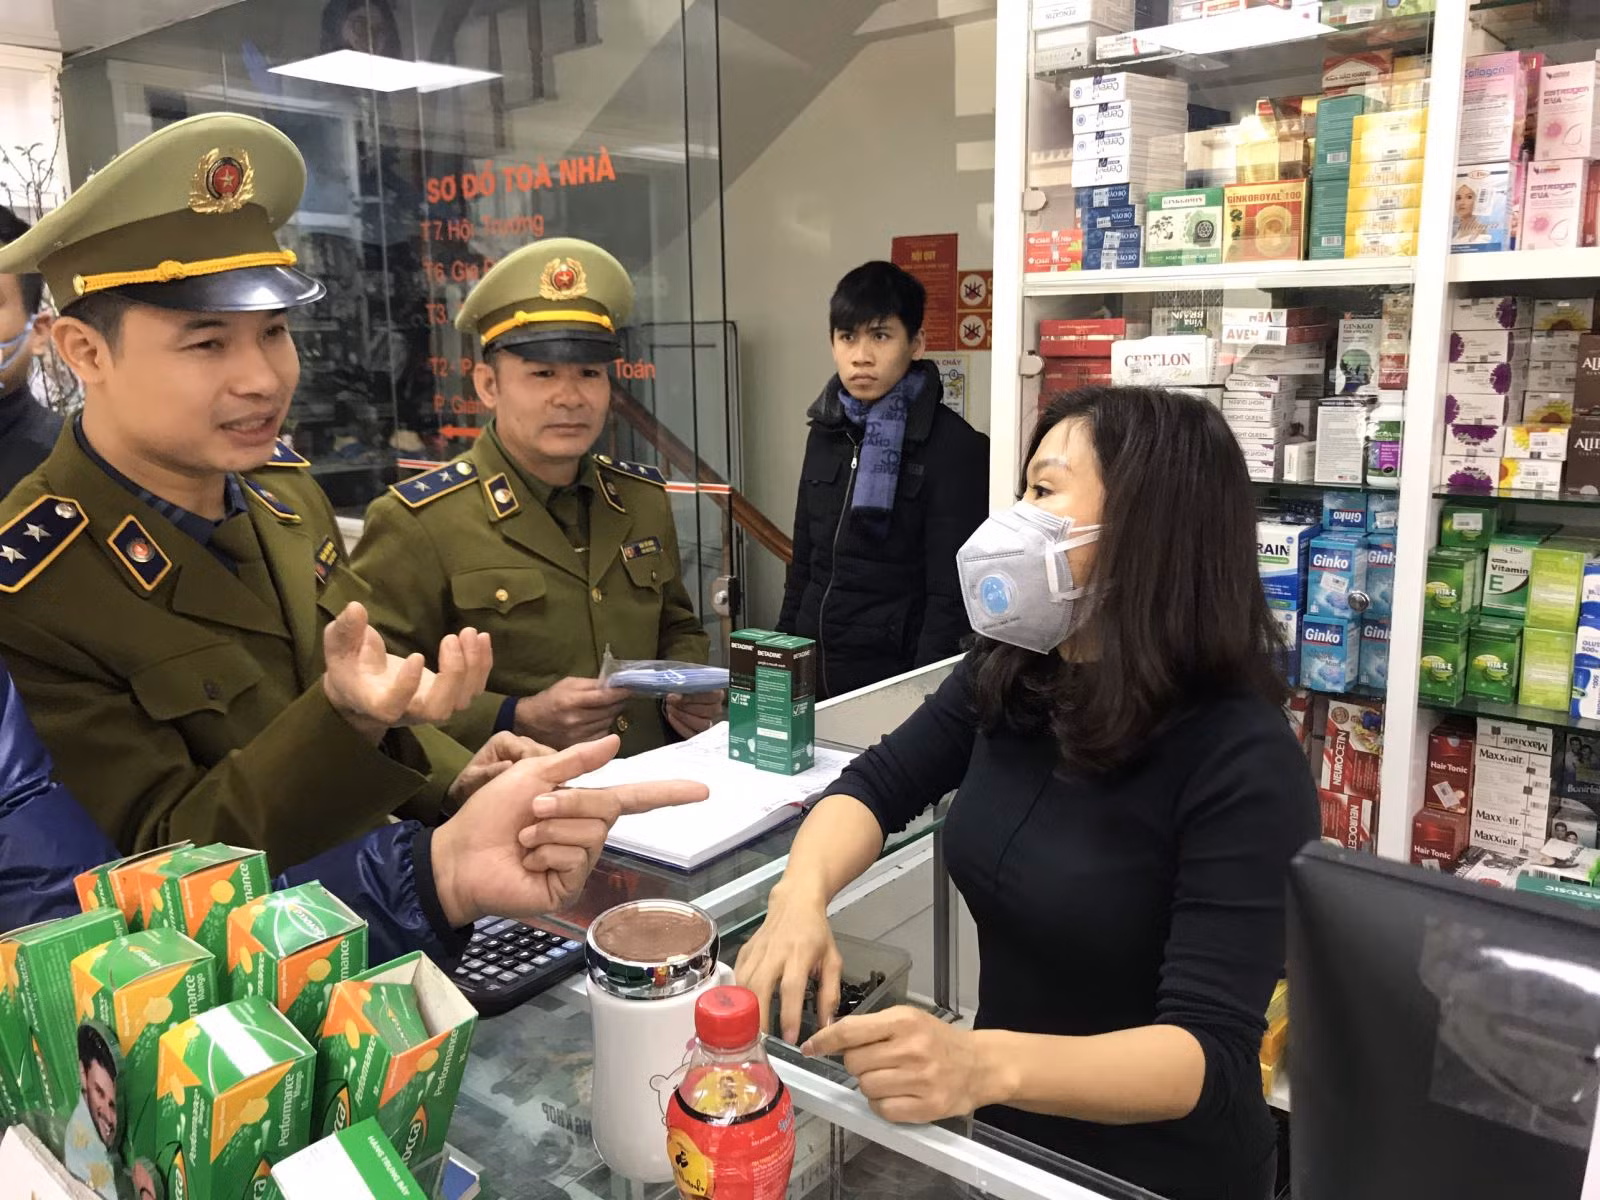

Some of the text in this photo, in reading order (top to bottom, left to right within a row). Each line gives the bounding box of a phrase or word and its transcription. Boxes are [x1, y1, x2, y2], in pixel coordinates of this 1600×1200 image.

[559, 146, 616, 187] NHÀ
[1285, 190, 1301, 201] 100
[614, 357, 656, 380] Toán
[1333, 511, 1363, 524] Ginko
[1313, 553, 1349, 570] Ginko
[1491, 563, 1529, 575] Vitamin
[1489, 574, 1505, 593] E
[1305, 627, 1341, 644] Ginko
[757, 649, 782, 659] BETADINE
[1430, 760, 1468, 774] Hair Tonic
[1414, 844, 1452, 860] Hair Tonic
[434, 1028, 459, 1098] Performance
[278, 1072, 296, 1149] Performance
